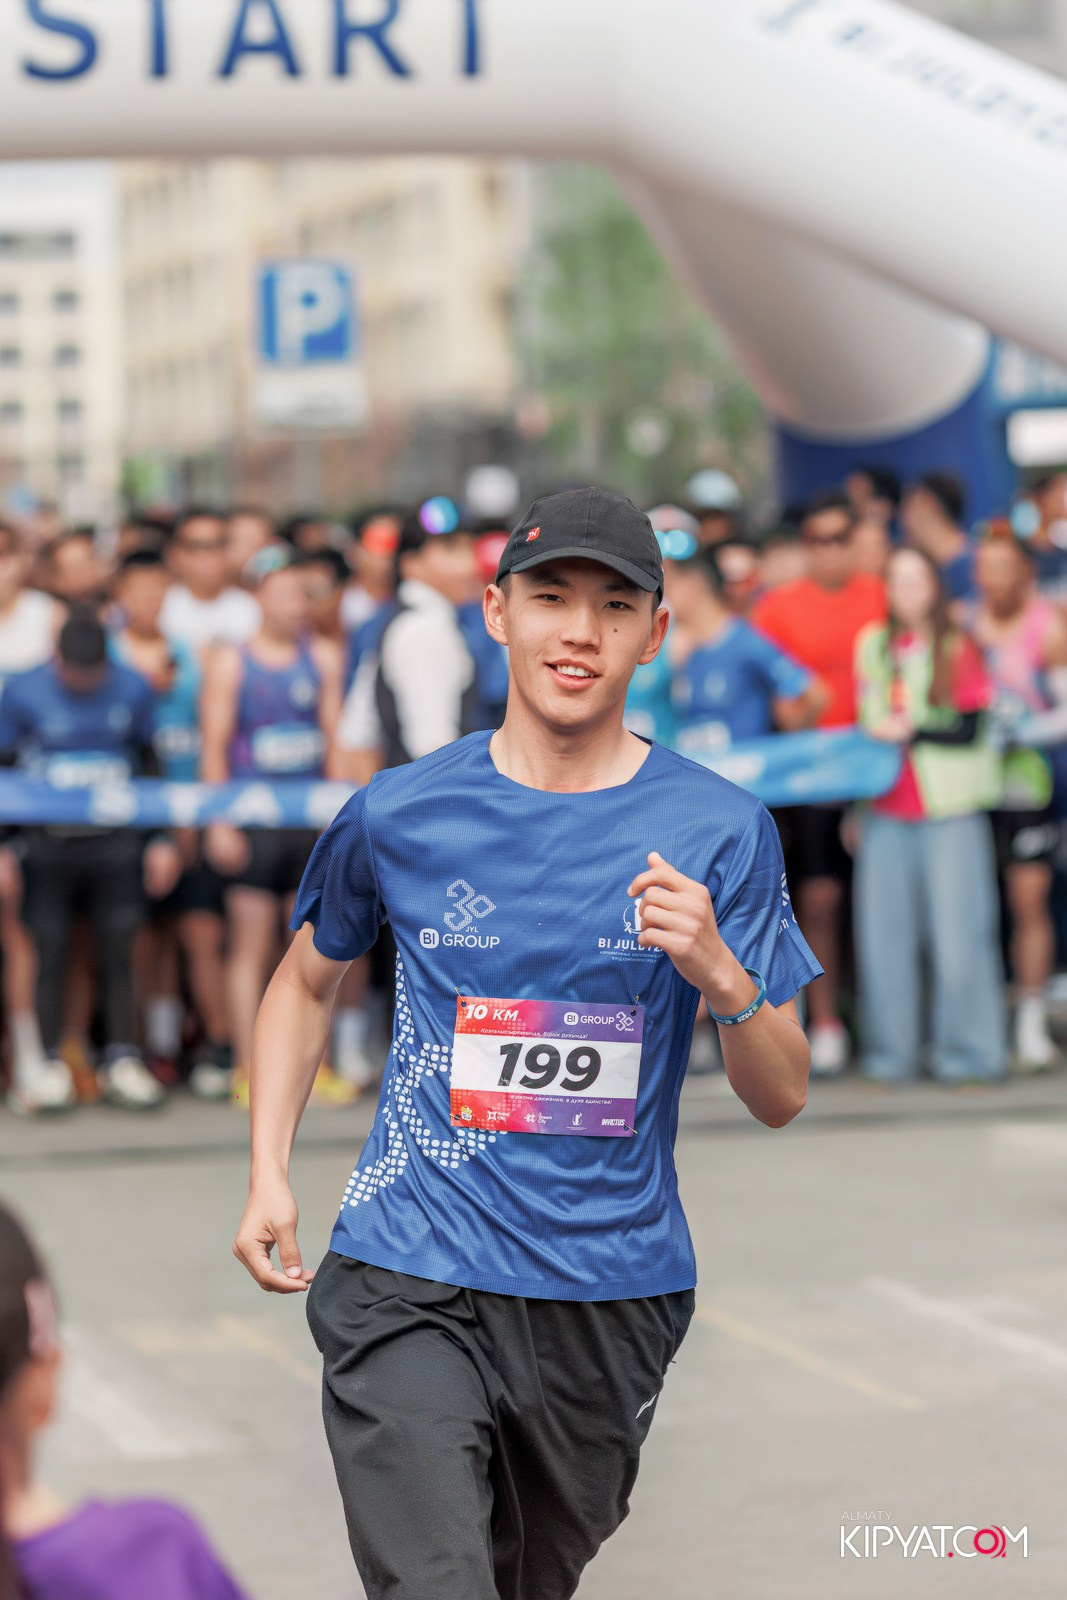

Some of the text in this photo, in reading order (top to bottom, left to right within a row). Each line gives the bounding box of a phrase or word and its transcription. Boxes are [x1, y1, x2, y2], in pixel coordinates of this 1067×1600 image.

[276, 264, 343, 363] P
[422, 930, 500, 948] BI GROUP
[598, 938, 610, 948] BI
[466, 1004, 519, 1022] 10 KM
[566, 1014, 577, 1024] BI
[580, 1015, 615, 1024] GROUP
[737, 1010, 754, 1022] 2025
[497, 1043, 602, 1092] 199
